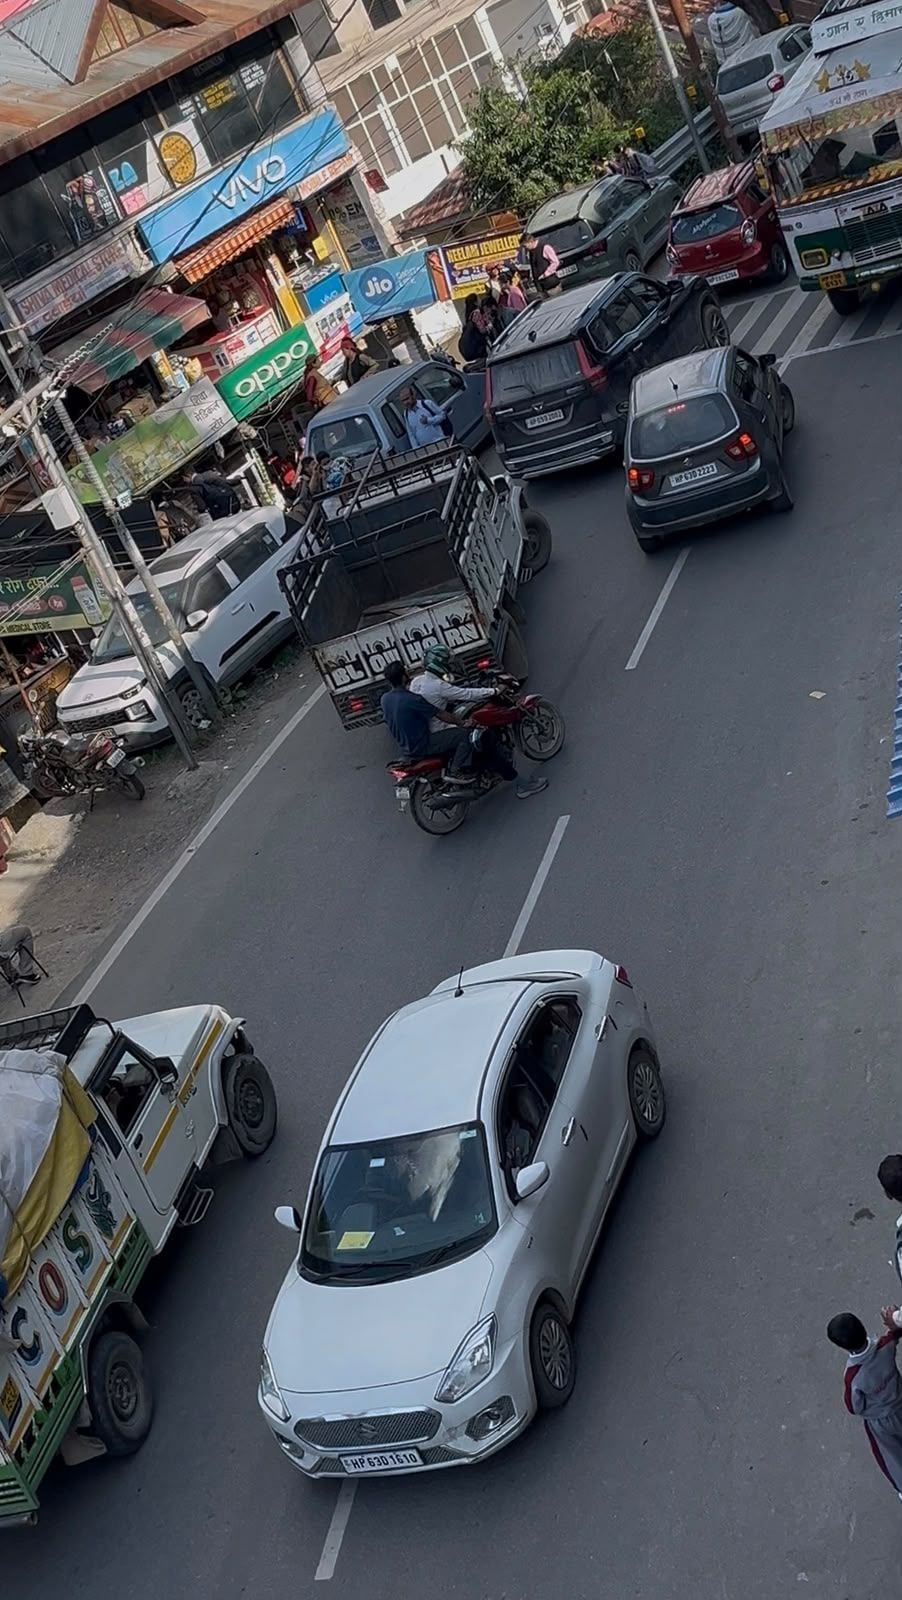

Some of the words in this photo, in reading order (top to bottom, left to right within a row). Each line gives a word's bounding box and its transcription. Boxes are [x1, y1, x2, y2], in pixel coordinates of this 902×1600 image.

[446, 243, 480, 263] NEELAM
[480, 233, 522, 256] JEWELLER
[21, 287, 54, 316] SHIVA
[51, 259, 93, 296] MEDICAL
[365, 276, 393, 298] Jio
[350, 1458, 366, 1470] HP
[389, 1453, 418, 1466] 1610
